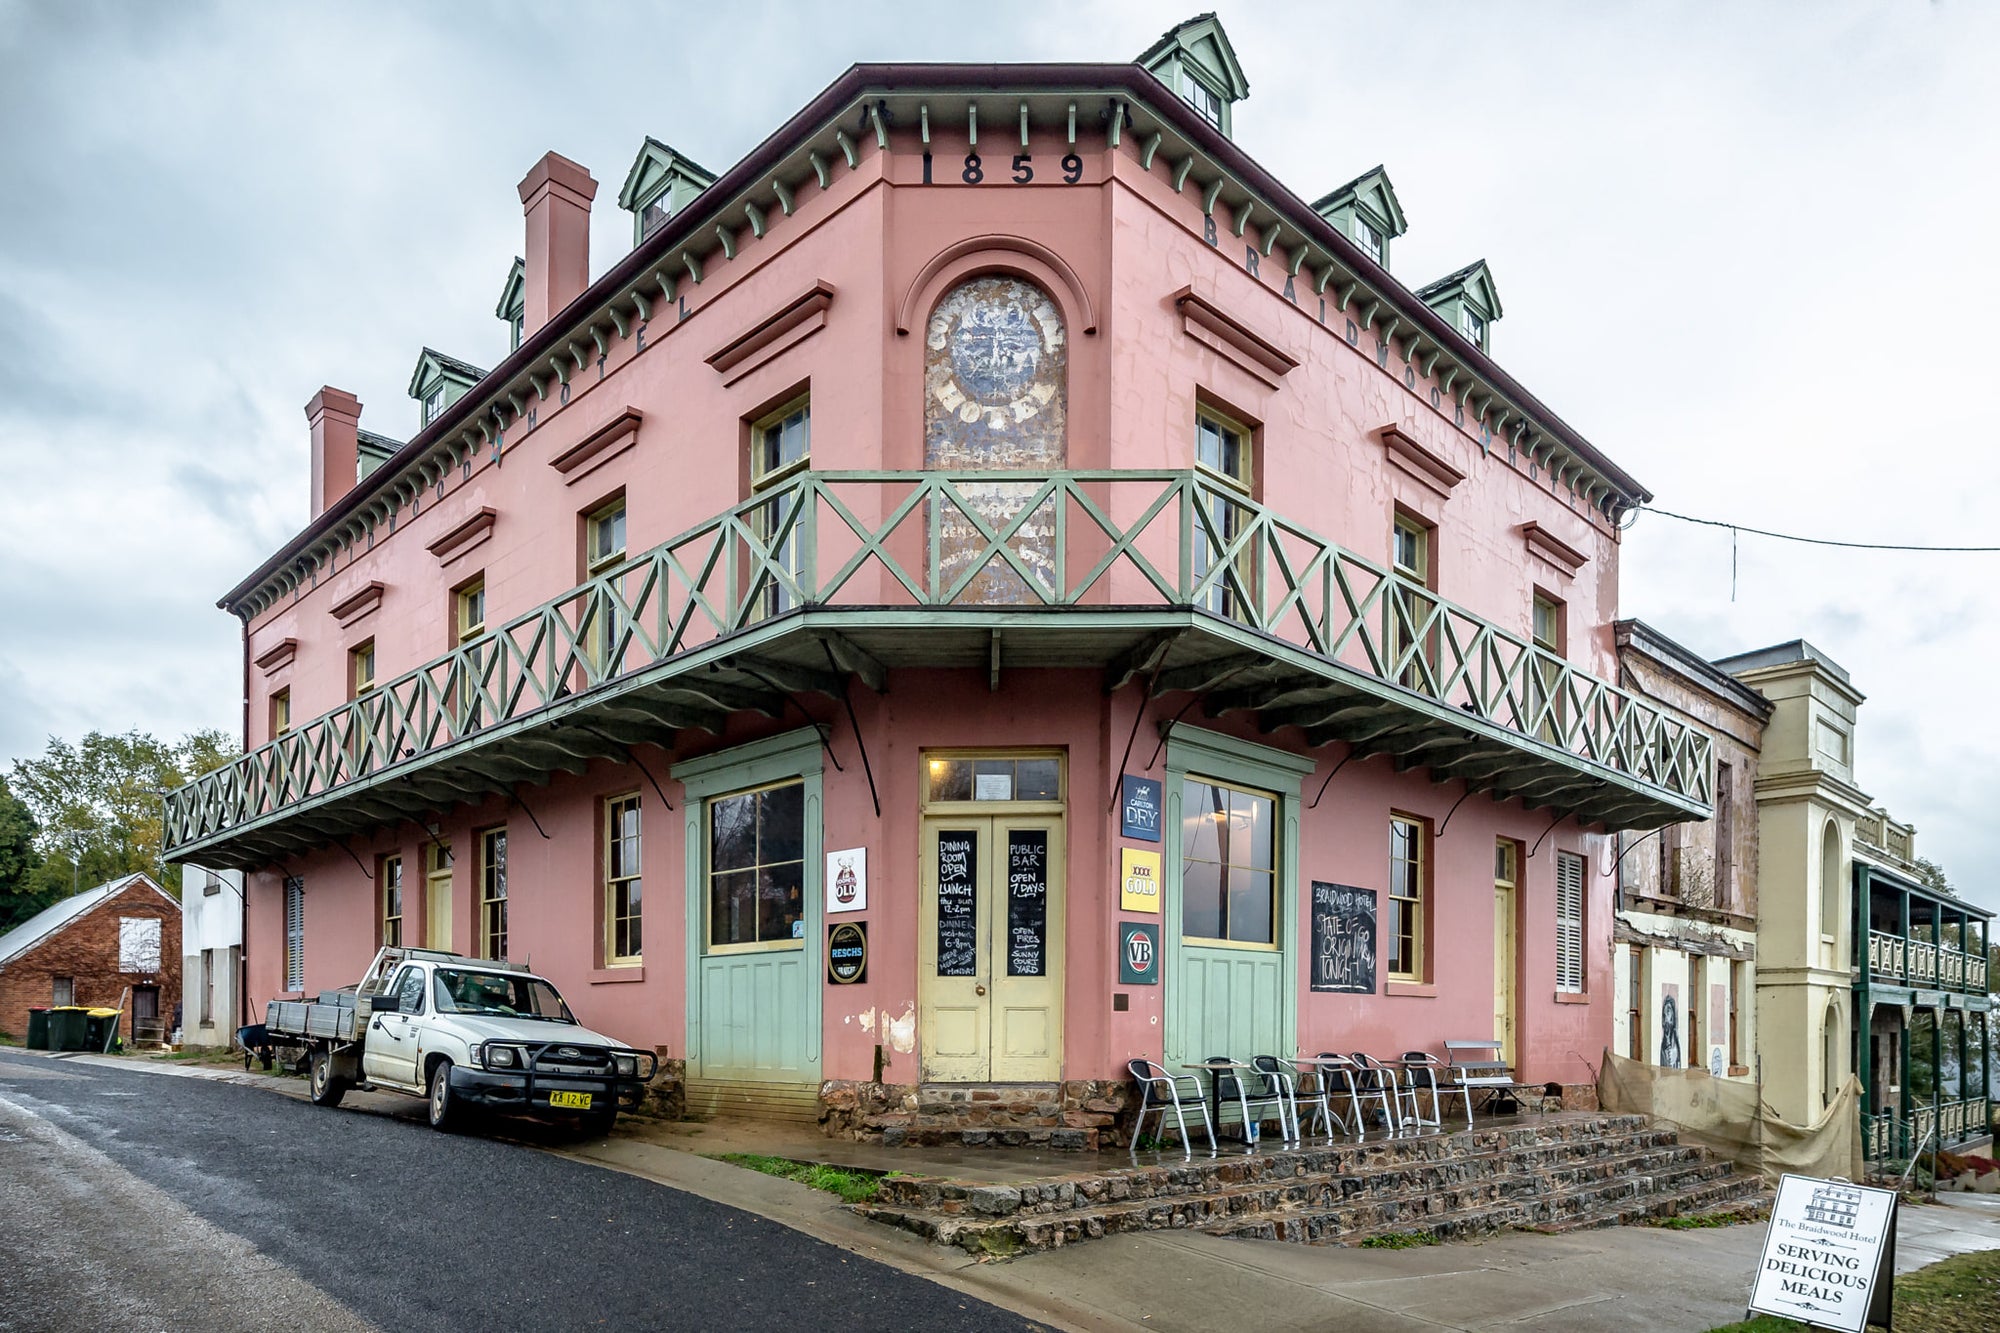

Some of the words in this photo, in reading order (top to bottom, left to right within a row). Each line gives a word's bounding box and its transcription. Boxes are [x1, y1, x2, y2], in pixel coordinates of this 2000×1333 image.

[922, 154, 1083, 184] 1859
[528, 295, 691, 433] HOTEL
[1203, 215, 1466, 428] BRAIDWOOD
[1508, 446, 1595, 522] HOTEL
[1130, 798, 1154, 809] CARLTON
[1126, 806, 1158, 828] DRY
[940, 841, 970, 852] DINING
[1010, 844, 1045, 856] PUBLIC
[940, 852, 967, 865] ROOM
[1012, 856, 1039, 867] BAR
[941, 863, 967, 875] OPEN
[1133, 866, 1151, 877] XXXX
[1010, 873, 1036, 883] OPEN
[836, 885, 856, 897] OLD
[939, 883, 972, 896] LUNCH
[1010, 884, 1019, 895] 7
[1020, 883, 1045, 893] DAYS
[1126, 877, 1156, 895] GOLD
[1316, 913, 1344, 936] STATE
[1016, 935, 1040, 944] FIRES
[832, 947, 862, 958] RESCHS
[1011, 951, 1039, 959] SUNNY
[1130, 942, 1150, 962] VB
[1016, 965, 1039, 974] YARD
[1778, 1218, 1797, 1230] The
[1798, 1223, 1849, 1240] Braidwood
[1850, 1231, 1877, 1244] Hotel
[1777, 1243, 1860, 1270] SERVING
[1766, 1258, 1868, 1290] DELICIOUS
[1780, 1279, 1844, 1303] MEALS
